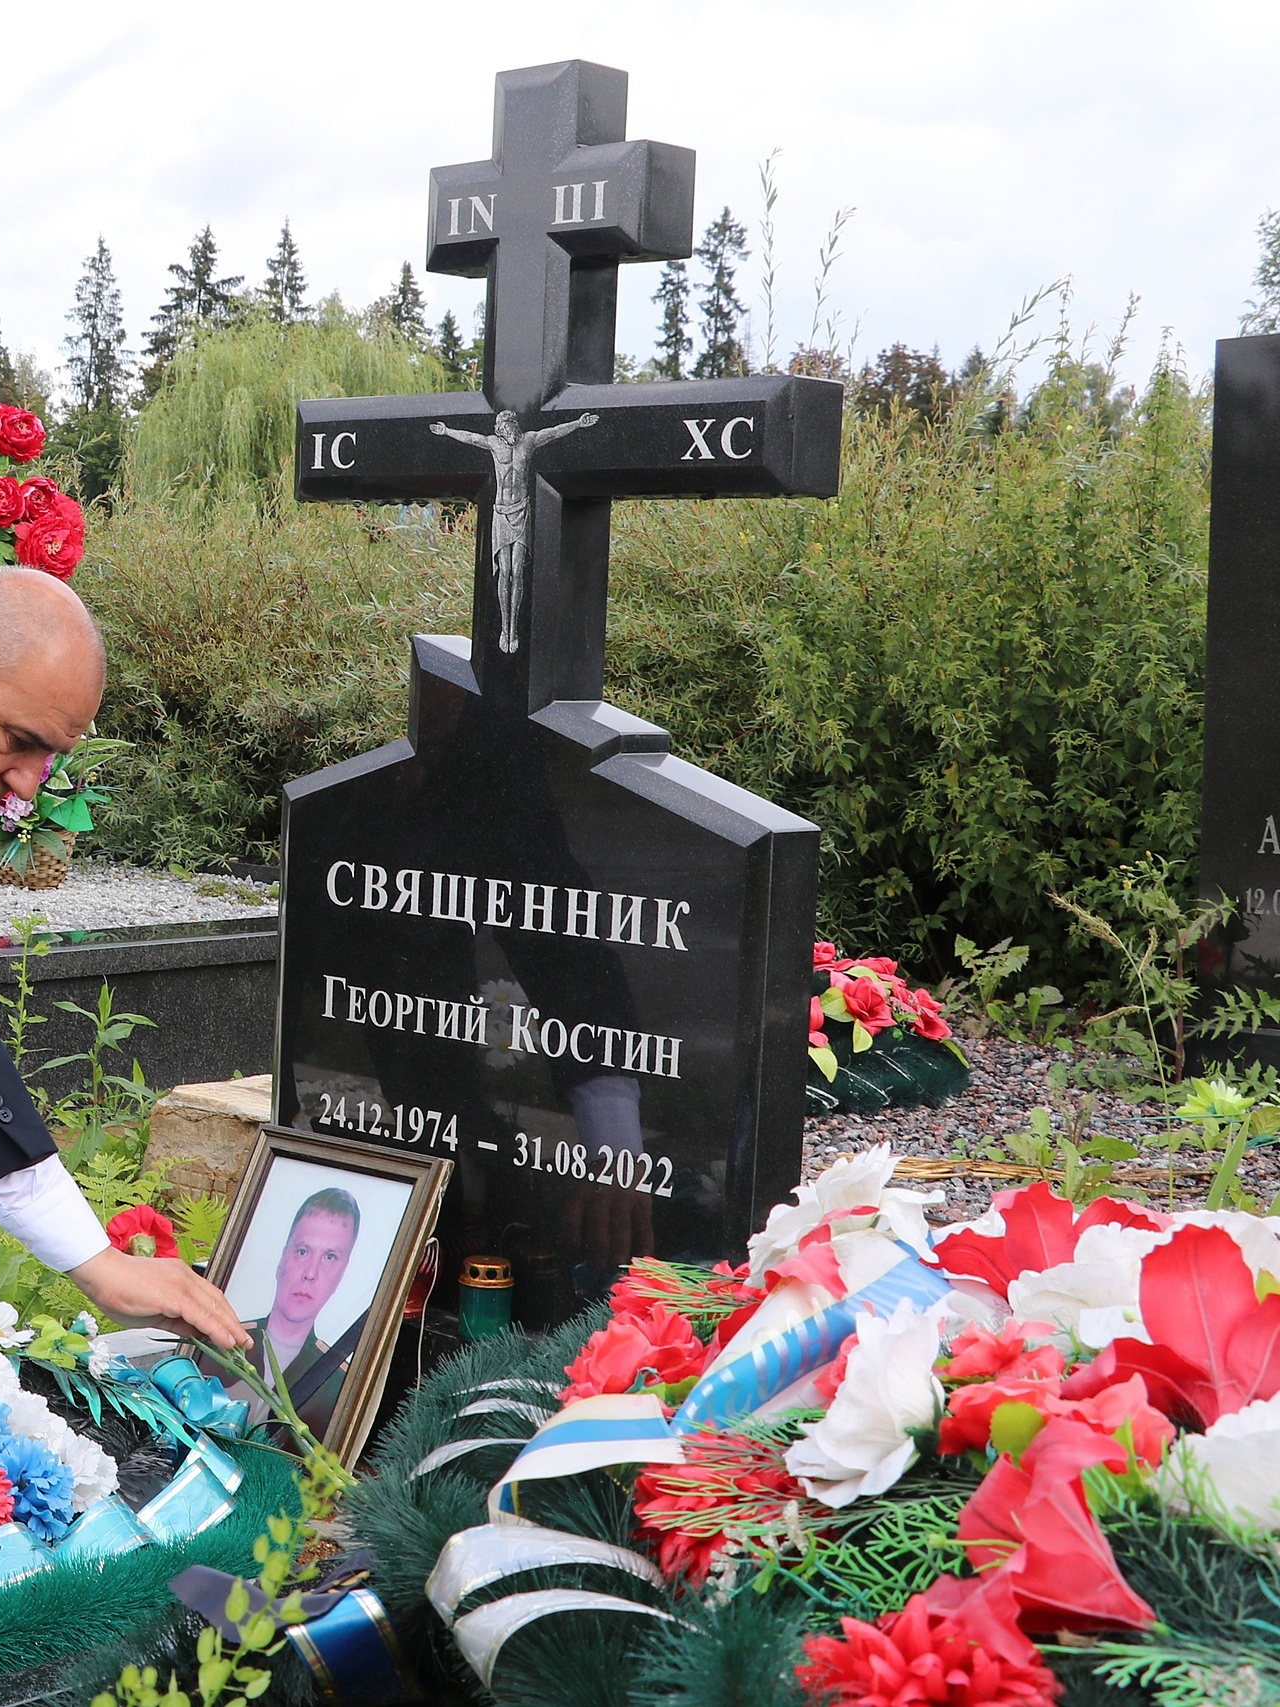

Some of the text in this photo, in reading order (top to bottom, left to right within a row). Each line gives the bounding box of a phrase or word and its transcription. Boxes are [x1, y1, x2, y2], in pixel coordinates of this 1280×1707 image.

[310, 416, 754, 470] IС ХС
[325, 860, 691, 952] СВЯЩЕННИК
[321, 974, 684, 1079] ГЕОРГИЙ КОСТИН
[318, 1093, 459, 1152] 24.12.1974
[513, 1132, 674, 1198] 31.08.2022
